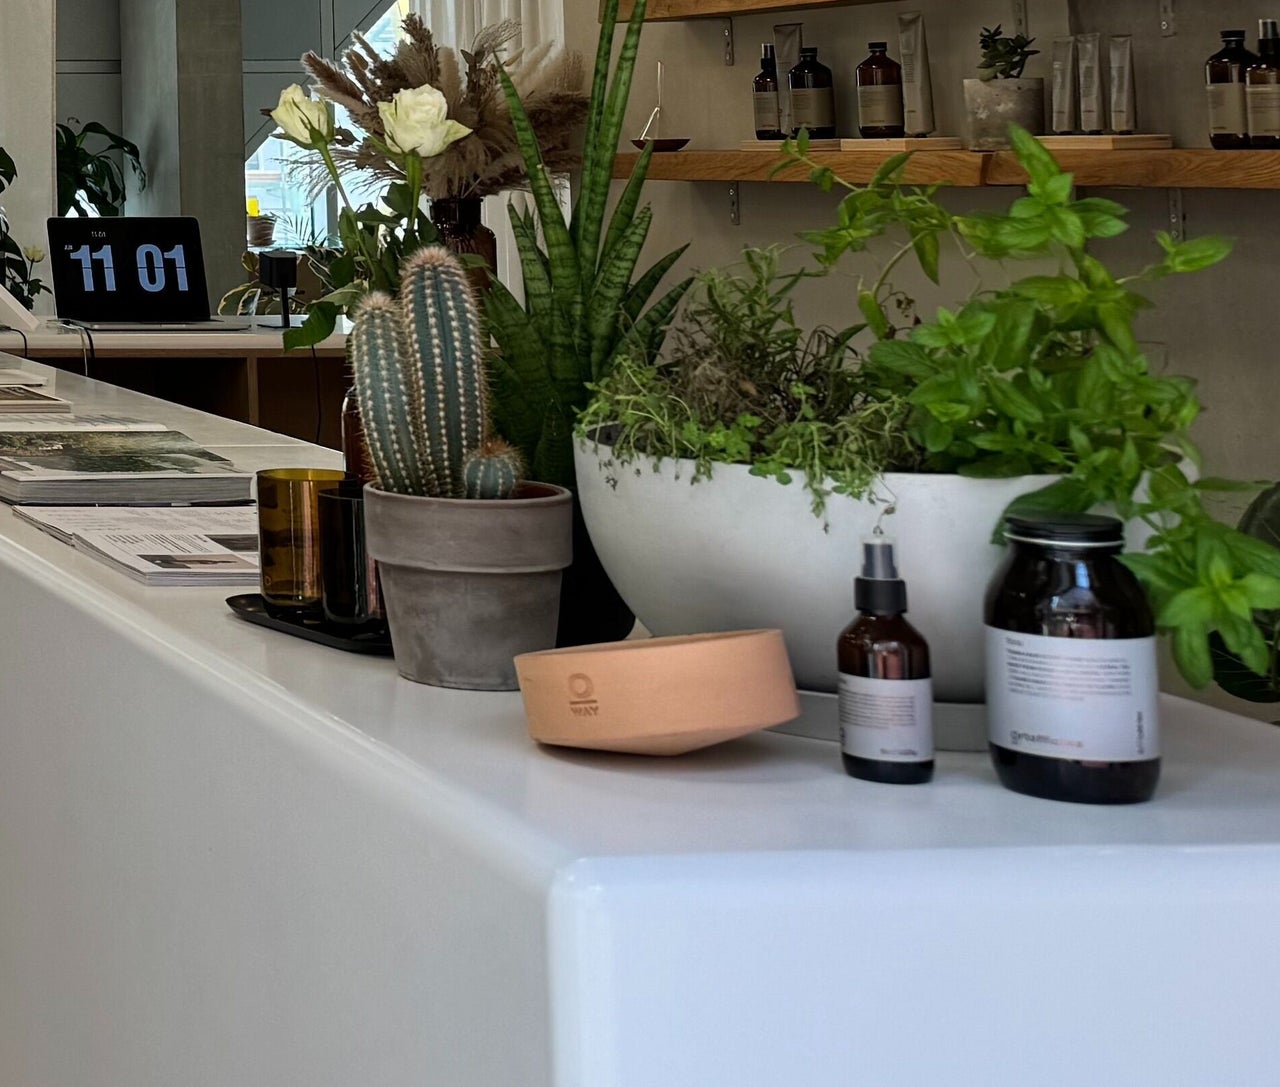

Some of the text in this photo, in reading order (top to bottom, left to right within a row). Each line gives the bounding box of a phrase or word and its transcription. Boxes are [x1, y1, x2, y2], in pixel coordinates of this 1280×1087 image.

[70, 244, 189, 292] 11 01
[569, 705, 599, 717] WAY
